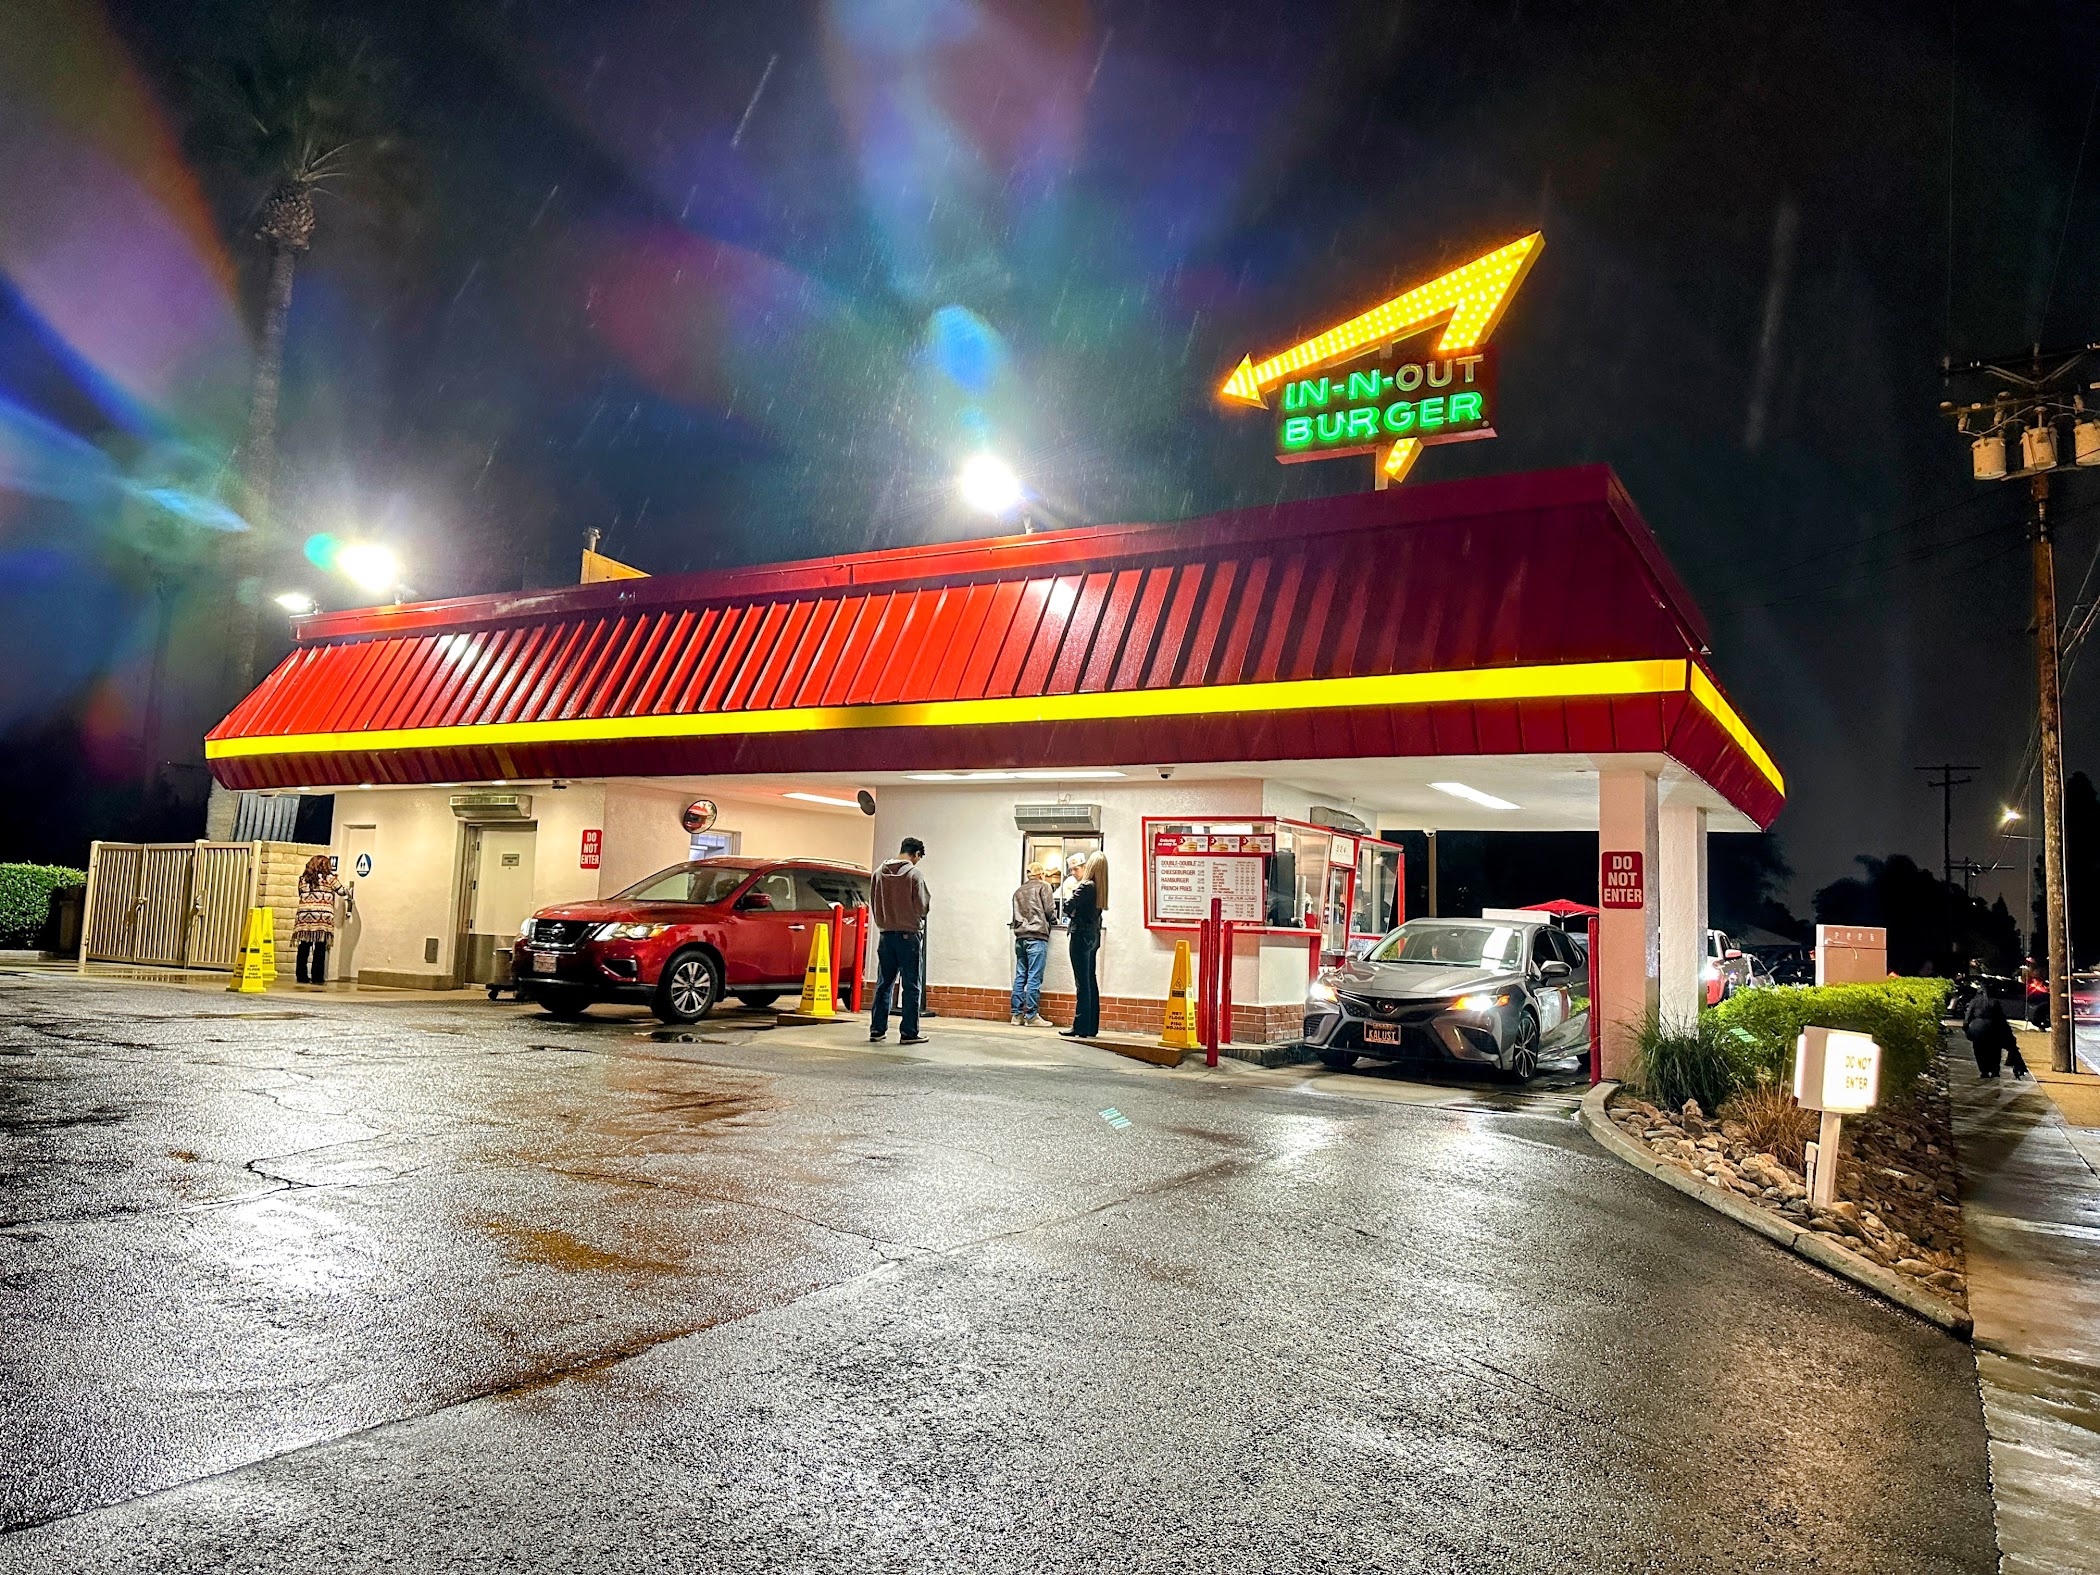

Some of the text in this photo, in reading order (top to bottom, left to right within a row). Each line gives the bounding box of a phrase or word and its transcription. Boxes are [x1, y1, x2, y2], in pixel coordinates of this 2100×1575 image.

[1284, 354, 1484, 410] IN-N-OUT
[1284, 391, 1483, 446] BURGER
[587, 832, 597, 842] DO
[583, 843, 598, 854] NOT
[581, 854, 599, 864] ENTER
[1612, 855, 1633, 870] DO
[1608, 872, 1638, 887] NOT
[1603, 888, 1643, 903] ENTER
[1845, 1055, 1872, 1070] DO NOT
[1845, 1075, 1868, 1090] ENTER
